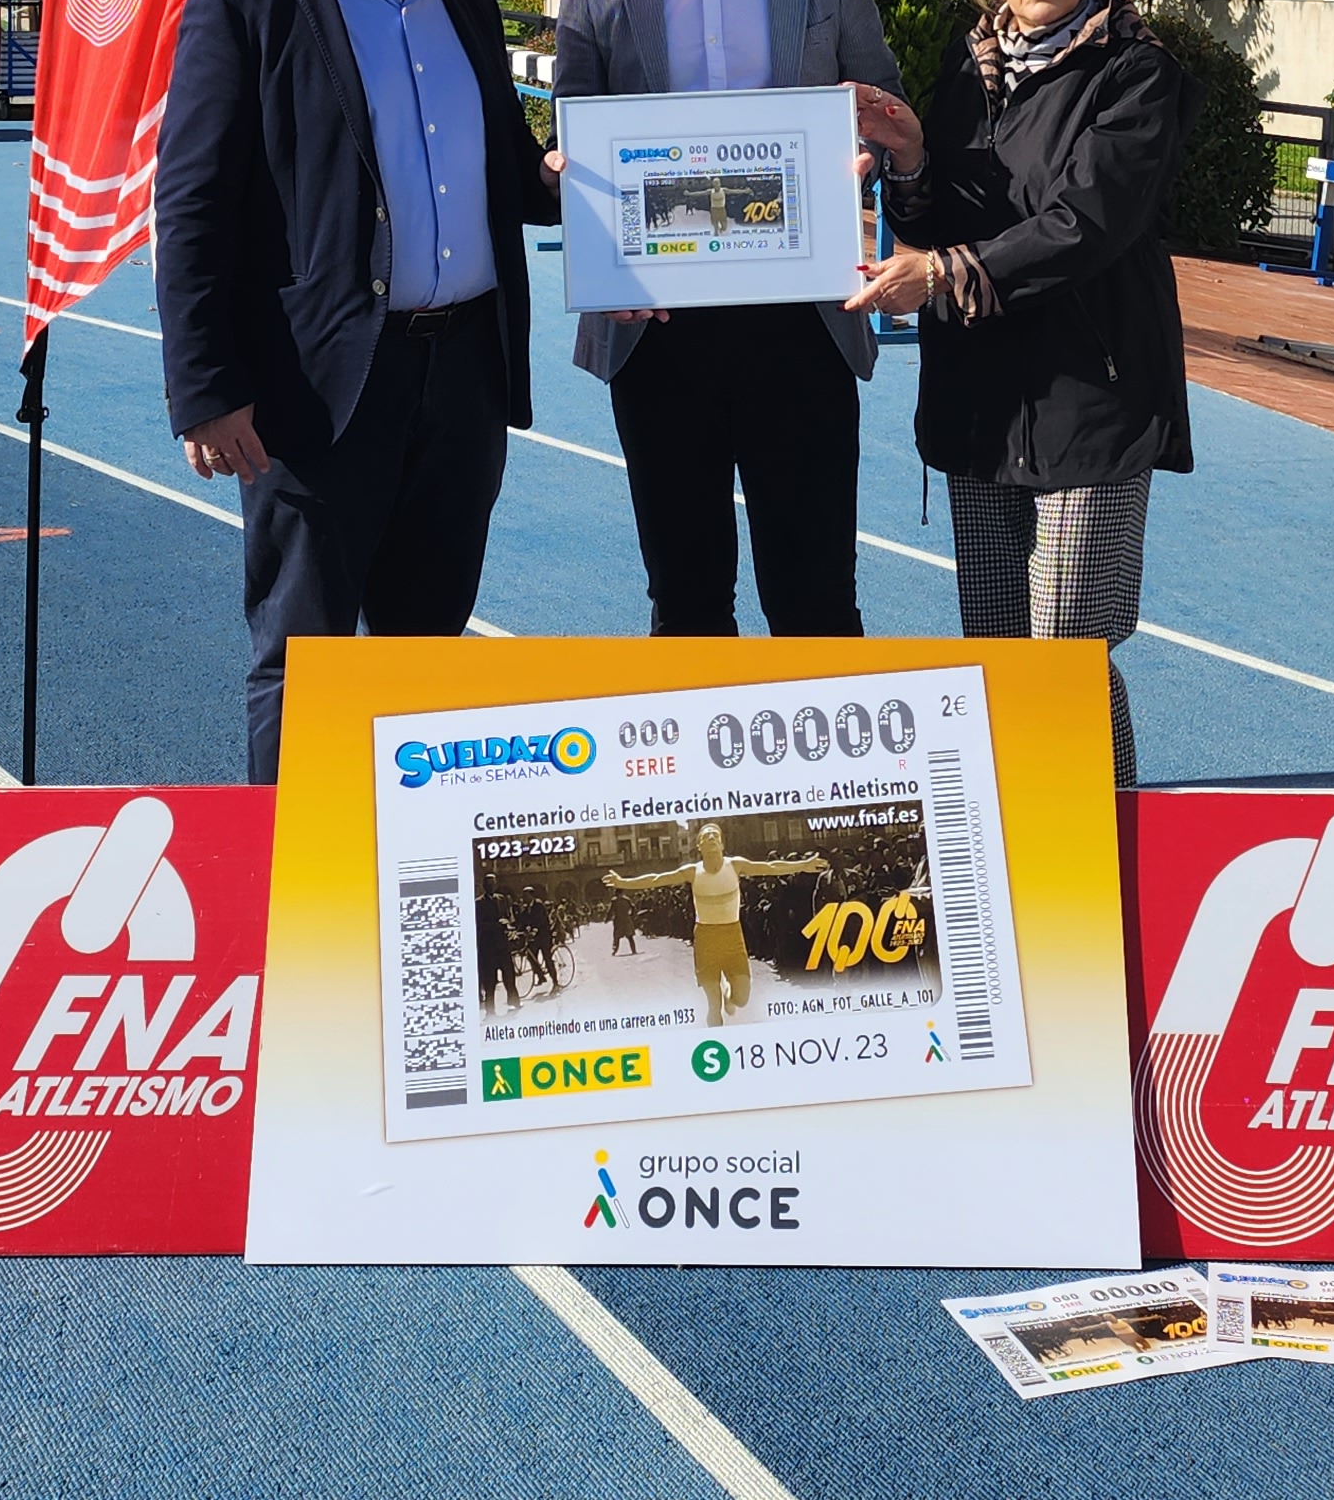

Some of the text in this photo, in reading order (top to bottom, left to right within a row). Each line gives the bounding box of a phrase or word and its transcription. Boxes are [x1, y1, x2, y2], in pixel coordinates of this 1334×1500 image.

[689, 145, 709, 154] 000
[717, 142, 782, 162] 00000
[789, 142, 799, 150] 2€
[661, 243, 695, 252] ONCE
[722, 242, 731, 250] 18
[733, 241, 756, 249] NOV.
[758, 240, 769, 248] 23
[837, 705, 855, 728] ONCE
[880, 702, 898, 725] ONCE
[941, 695, 967, 717] 2€
[709, 716, 728, 740] ONCE
[752, 712, 771, 736] ONCE
[794, 708, 813, 732] ONCE
[619, 718, 679, 748] 000
[707, 699, 916, 768] 00000
[852, 732, 871, 756] ONCE
[895, 728, 913, 752] ONCE
[395, 726, 597, 788] SUELDAZO
[723, 742, 743, 766] ONCE
[767, 738, 785, 762] ONCE
[809, 735, 827, 759] ONCE
[469, 774, 483, 784] de
[486, 765, 551, 782] SEMANA
[625, 756, 675, 777] SERIE
[899, 759, 907, 770] R
[473, 778, 919, 832] Centenario de la Federación Navarra de Atletismo
[807, 807, 919, 830] www.fnaf.es
[477, 836, 575, 860] 1923-2023
[893, 918, 925, 934] FNA
[768, 990, 934, 1016] FOTO: AGN_FOT_GALLE_A_101
[12, 975, 259, 1072] FNA
[485, 1008, 695, 1042] Atleta compitiendo en una carrera en 1933
[703, 1033, 889, 1074] S 18 NOV. 23
[531, 1052, 643, 1090] ONCE
[639, 1150, 800, 1179] grupo social
[638, 1186, 800, 1230] ONCE
[1053, 1293, 1079, 1304] 000
[1089, 1280, 1180, 1302] 00000
[1169, 1350, 1201, 1360] NOV.
[1273, 1340, 1326, 1352] ONCE
[1070, 1362, 1120, 1378] ONCE
